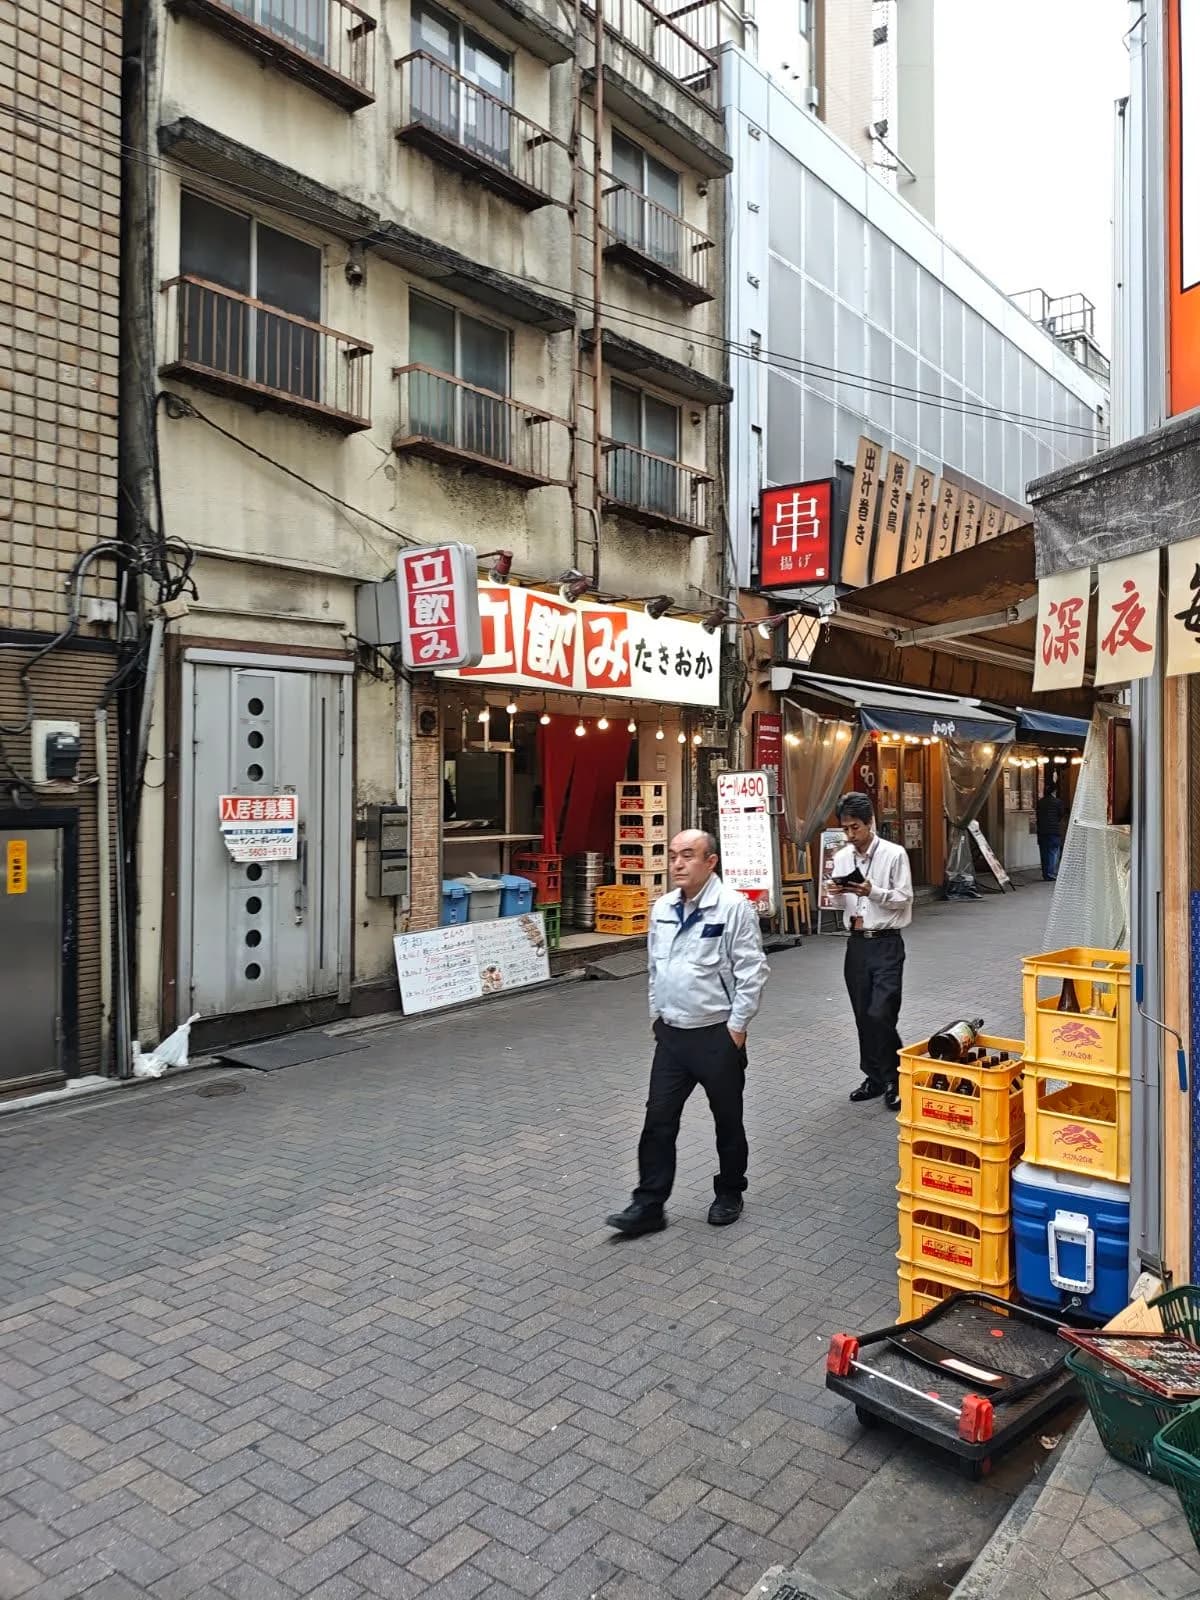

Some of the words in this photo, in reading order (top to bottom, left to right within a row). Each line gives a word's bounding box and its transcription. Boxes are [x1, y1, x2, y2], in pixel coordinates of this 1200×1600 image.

[772, 492, 821, 552] 串
[779, 553, 812, 571] 揚げ
[410, 553, 452, 661] 立飲み
[479, 590, 631, 683] 立飲み
[634, 636, 714, 680] たきおか
[223, 799, 293, 820] 入居者募集
[924, 1101, 970, 1113] ホッピー
[924, 1171, 970, 1183] ホッピー
[924, 1240, 970, 1253] ホッピー
